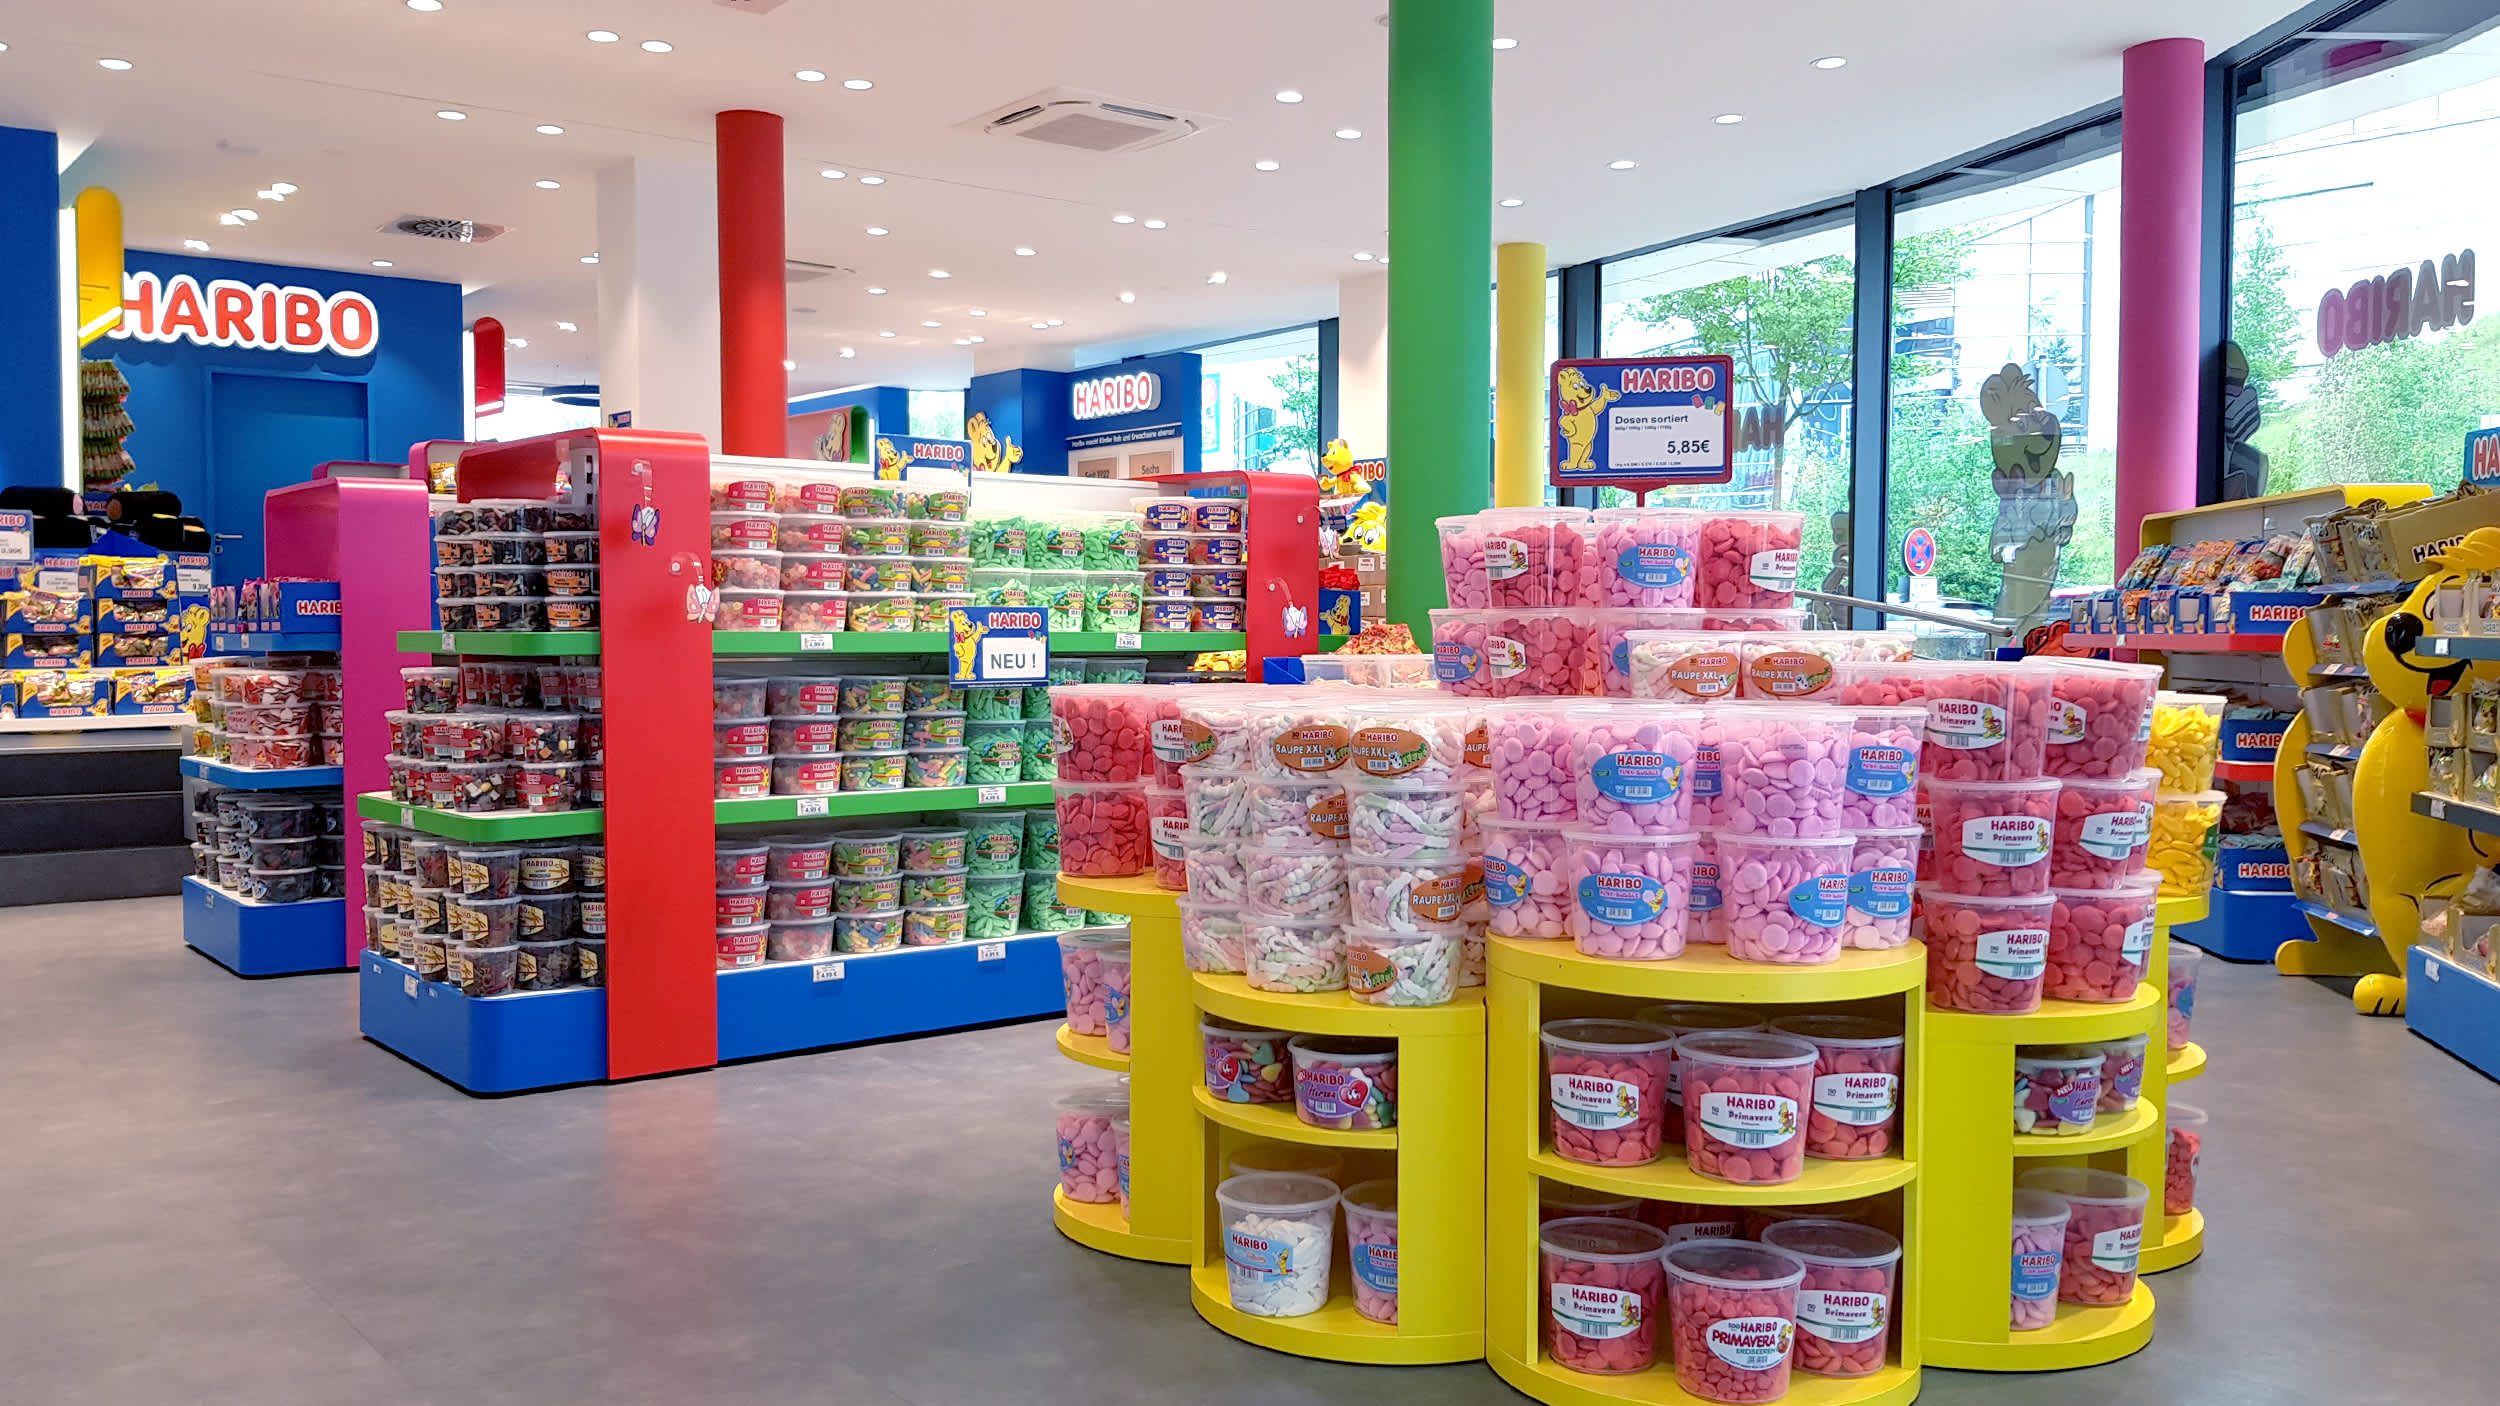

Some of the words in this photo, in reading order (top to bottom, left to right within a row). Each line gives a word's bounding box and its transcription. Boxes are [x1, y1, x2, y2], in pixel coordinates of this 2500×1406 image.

[106, 279, 373, 351] HARIBO
[1622, 367, 1716, 393] HARIBO
[1076, 374, 1151, 417] HARIBO
[1615, 415, 1648, 425] Dosen
[1650, 414, 1689, 424] sortiert
[915, 444, 964, 460] HARIBO
[1666, 439, 1711, 455] 5,85€
[1639, 548, 1676, 557] HARIBO
[989, 613, 1042, 628] HARIBO
[990, 654, 1026, 669] NEU
[1699, 656, 1728, 666] HARIBO
[1773, 657, 1805, 665] HARIBO
[1671, 669, 1700, 680] RAUPE
[1702, 669, 1718, 679] XXL
[1751, 668, 1775, 679] RAUPE
[1777, 669, 1794, 679] XXL
[1938, 703, 1979, 715] HARIBO
[1939, 716, 1976, 726] Primavera
[1162, 723, 1183, 733] HARI
[1302, 730, 1334, 740] HARIBO
[1366, 733, 1398, 742] HARIBO
[1275, 744, 1304, 755] RAUPE
[1306, 743, 1323, 754] XXL
[1371, 747, 1386, 757] XXL
[1861, 749, 1903, 761] HARIBO
[1617, 754, 1662, 766] HARIBO
[1310, 813, 1337, 823] RAUPE
[1990, 820, 2035, 832] HARIBO
[1993, 833, 2033, 843] Primavera
[1598, 876, 1642, 889] HARIBO
[1872, 871, 1908, 882] HARIBO
[1412, 894, 1441, 905] RAUPE
[2006, 933, 2043, 945] HARIBO
[2008, 946, 2041, 956] Primavera
[2120, 1061, 2134, 1073] NEU
[1304, 1071, 1345, 1085] HARIBO
[1844, 1076, 1887, 1088] HARIBO
[1569, 1076, 1614, 1094] HARIBO
[2056, 1082, 2074, 1096] NEU
[1570, 1091, 1612, 1105] Primavera
[1846, 1090, 1884, 1100] Primavera
[1726, 1096, 1776, 1111] HARIBO
[1729, 1110, 1773, 1122] Primavera
[1693, 1224, 1731, 1237] HARIBO
[1232, 1233, 1269, 1251] HARIBO
[2021, 1254, 2056, 1267] HARIBO
[1571, 1288, 1618, 1304] HARIBO
[1823, 1293, 1870, 1307] HARIBO
[1573, 1302, 1616, 1315] Primavera
[1825, 1307, 1867, 1319] Primavera
[1740, 1321, 1778, 1333] HARIBO
[1711, 1329, 1776, 1348] PRIMAVERA
